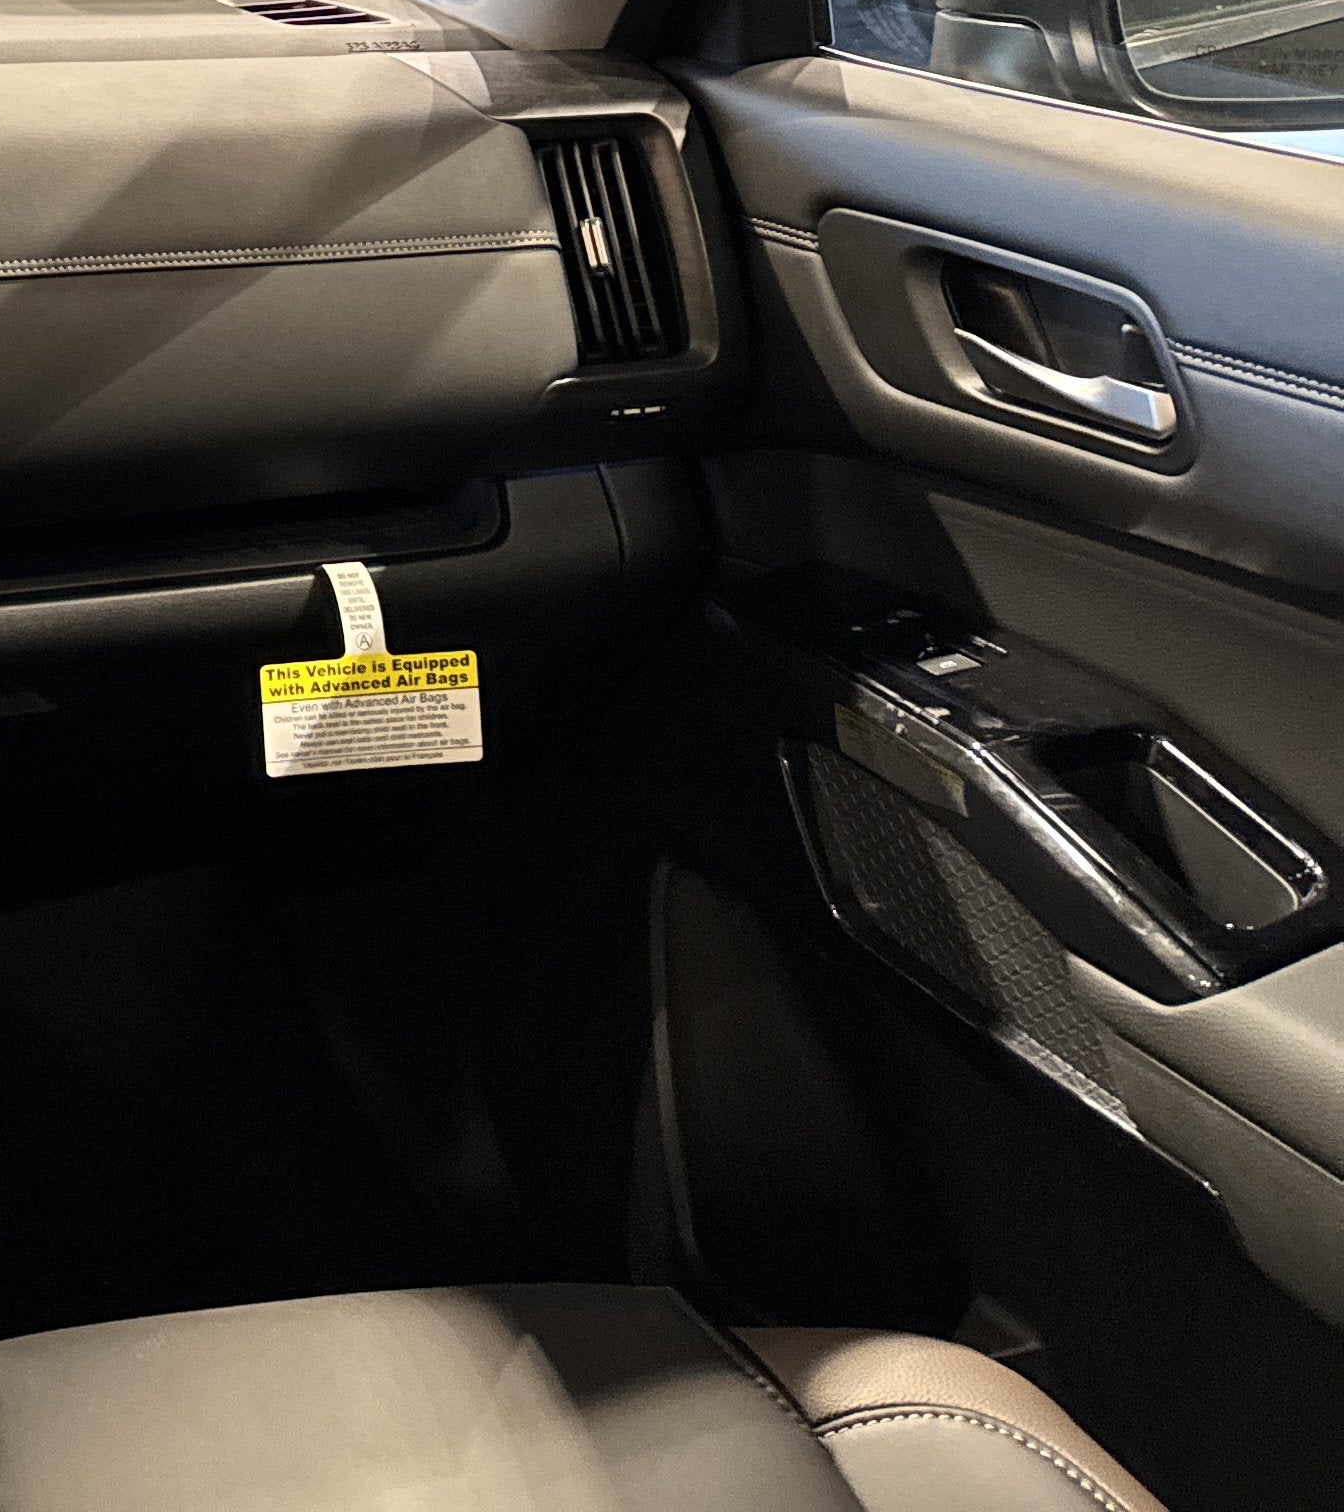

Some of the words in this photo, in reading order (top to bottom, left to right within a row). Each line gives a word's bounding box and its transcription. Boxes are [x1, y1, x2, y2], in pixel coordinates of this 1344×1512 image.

[359, 634, 370, 646] A
[265, 668, 301, 681] This
[306, 662, 367, 678] Vehicle
[372, 660, 387, 673] is
[392, 654, 470, 672] Equipped
[269, 682, 305, 697] with
[311, 675, 391, 693] Advanced
[396, 674, 421, 687] Air
[426, 672, 469, 686] Bags
[291, 701, 319, 713] Even
[321, 699, 343, 711] with
[345, 694, 399, 708] Advanced
[401, 694, 417, 704] Air
[419, 693, 449, 705] Bags
